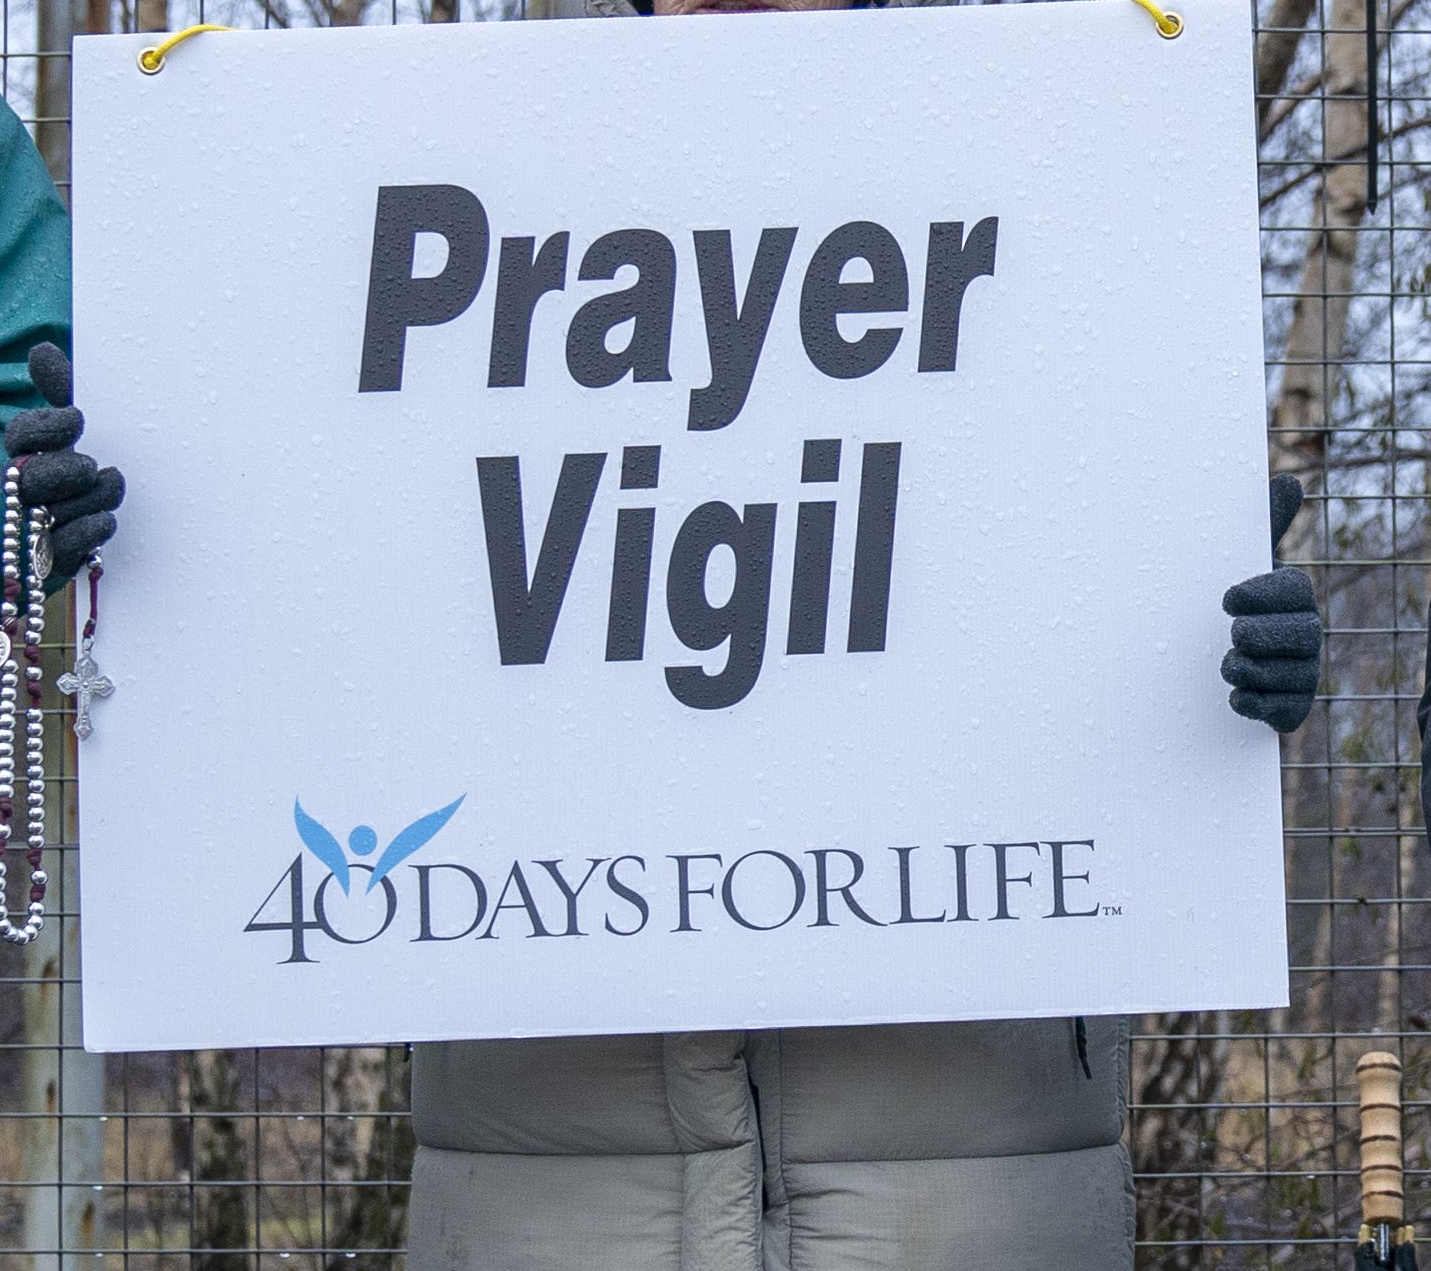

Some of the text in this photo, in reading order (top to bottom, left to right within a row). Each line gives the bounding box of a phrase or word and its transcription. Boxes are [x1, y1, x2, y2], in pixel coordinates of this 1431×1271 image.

[357, 183, 999, 432] Prayer
[475, 438, 903, 709] Vigil
[243, 851, 398, 964] 40
[409, 854, 650, 943] DAYS
[665, 846, 888, 933] FOR
